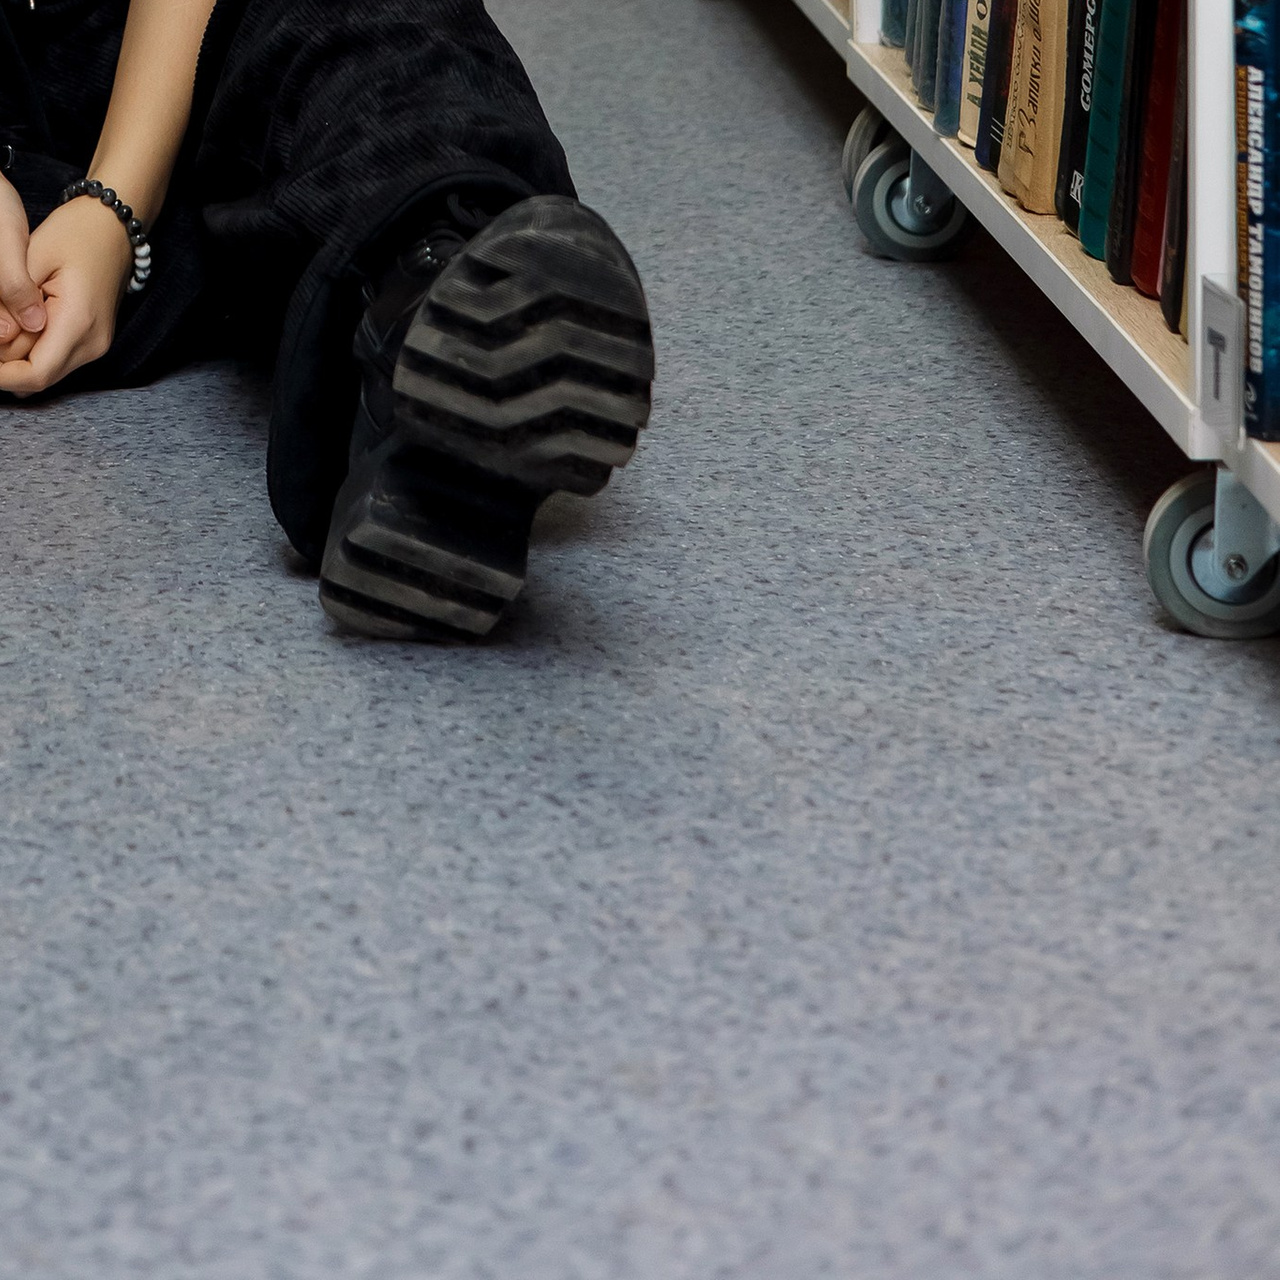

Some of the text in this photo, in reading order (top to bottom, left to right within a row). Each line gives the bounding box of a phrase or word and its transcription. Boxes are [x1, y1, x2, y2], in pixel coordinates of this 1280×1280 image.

[968, 23, 989, 87] ХЕЙЛИ
[1246, 65, 1265, 374] АЛЕКСАНДР ТАМОНИКОВ
